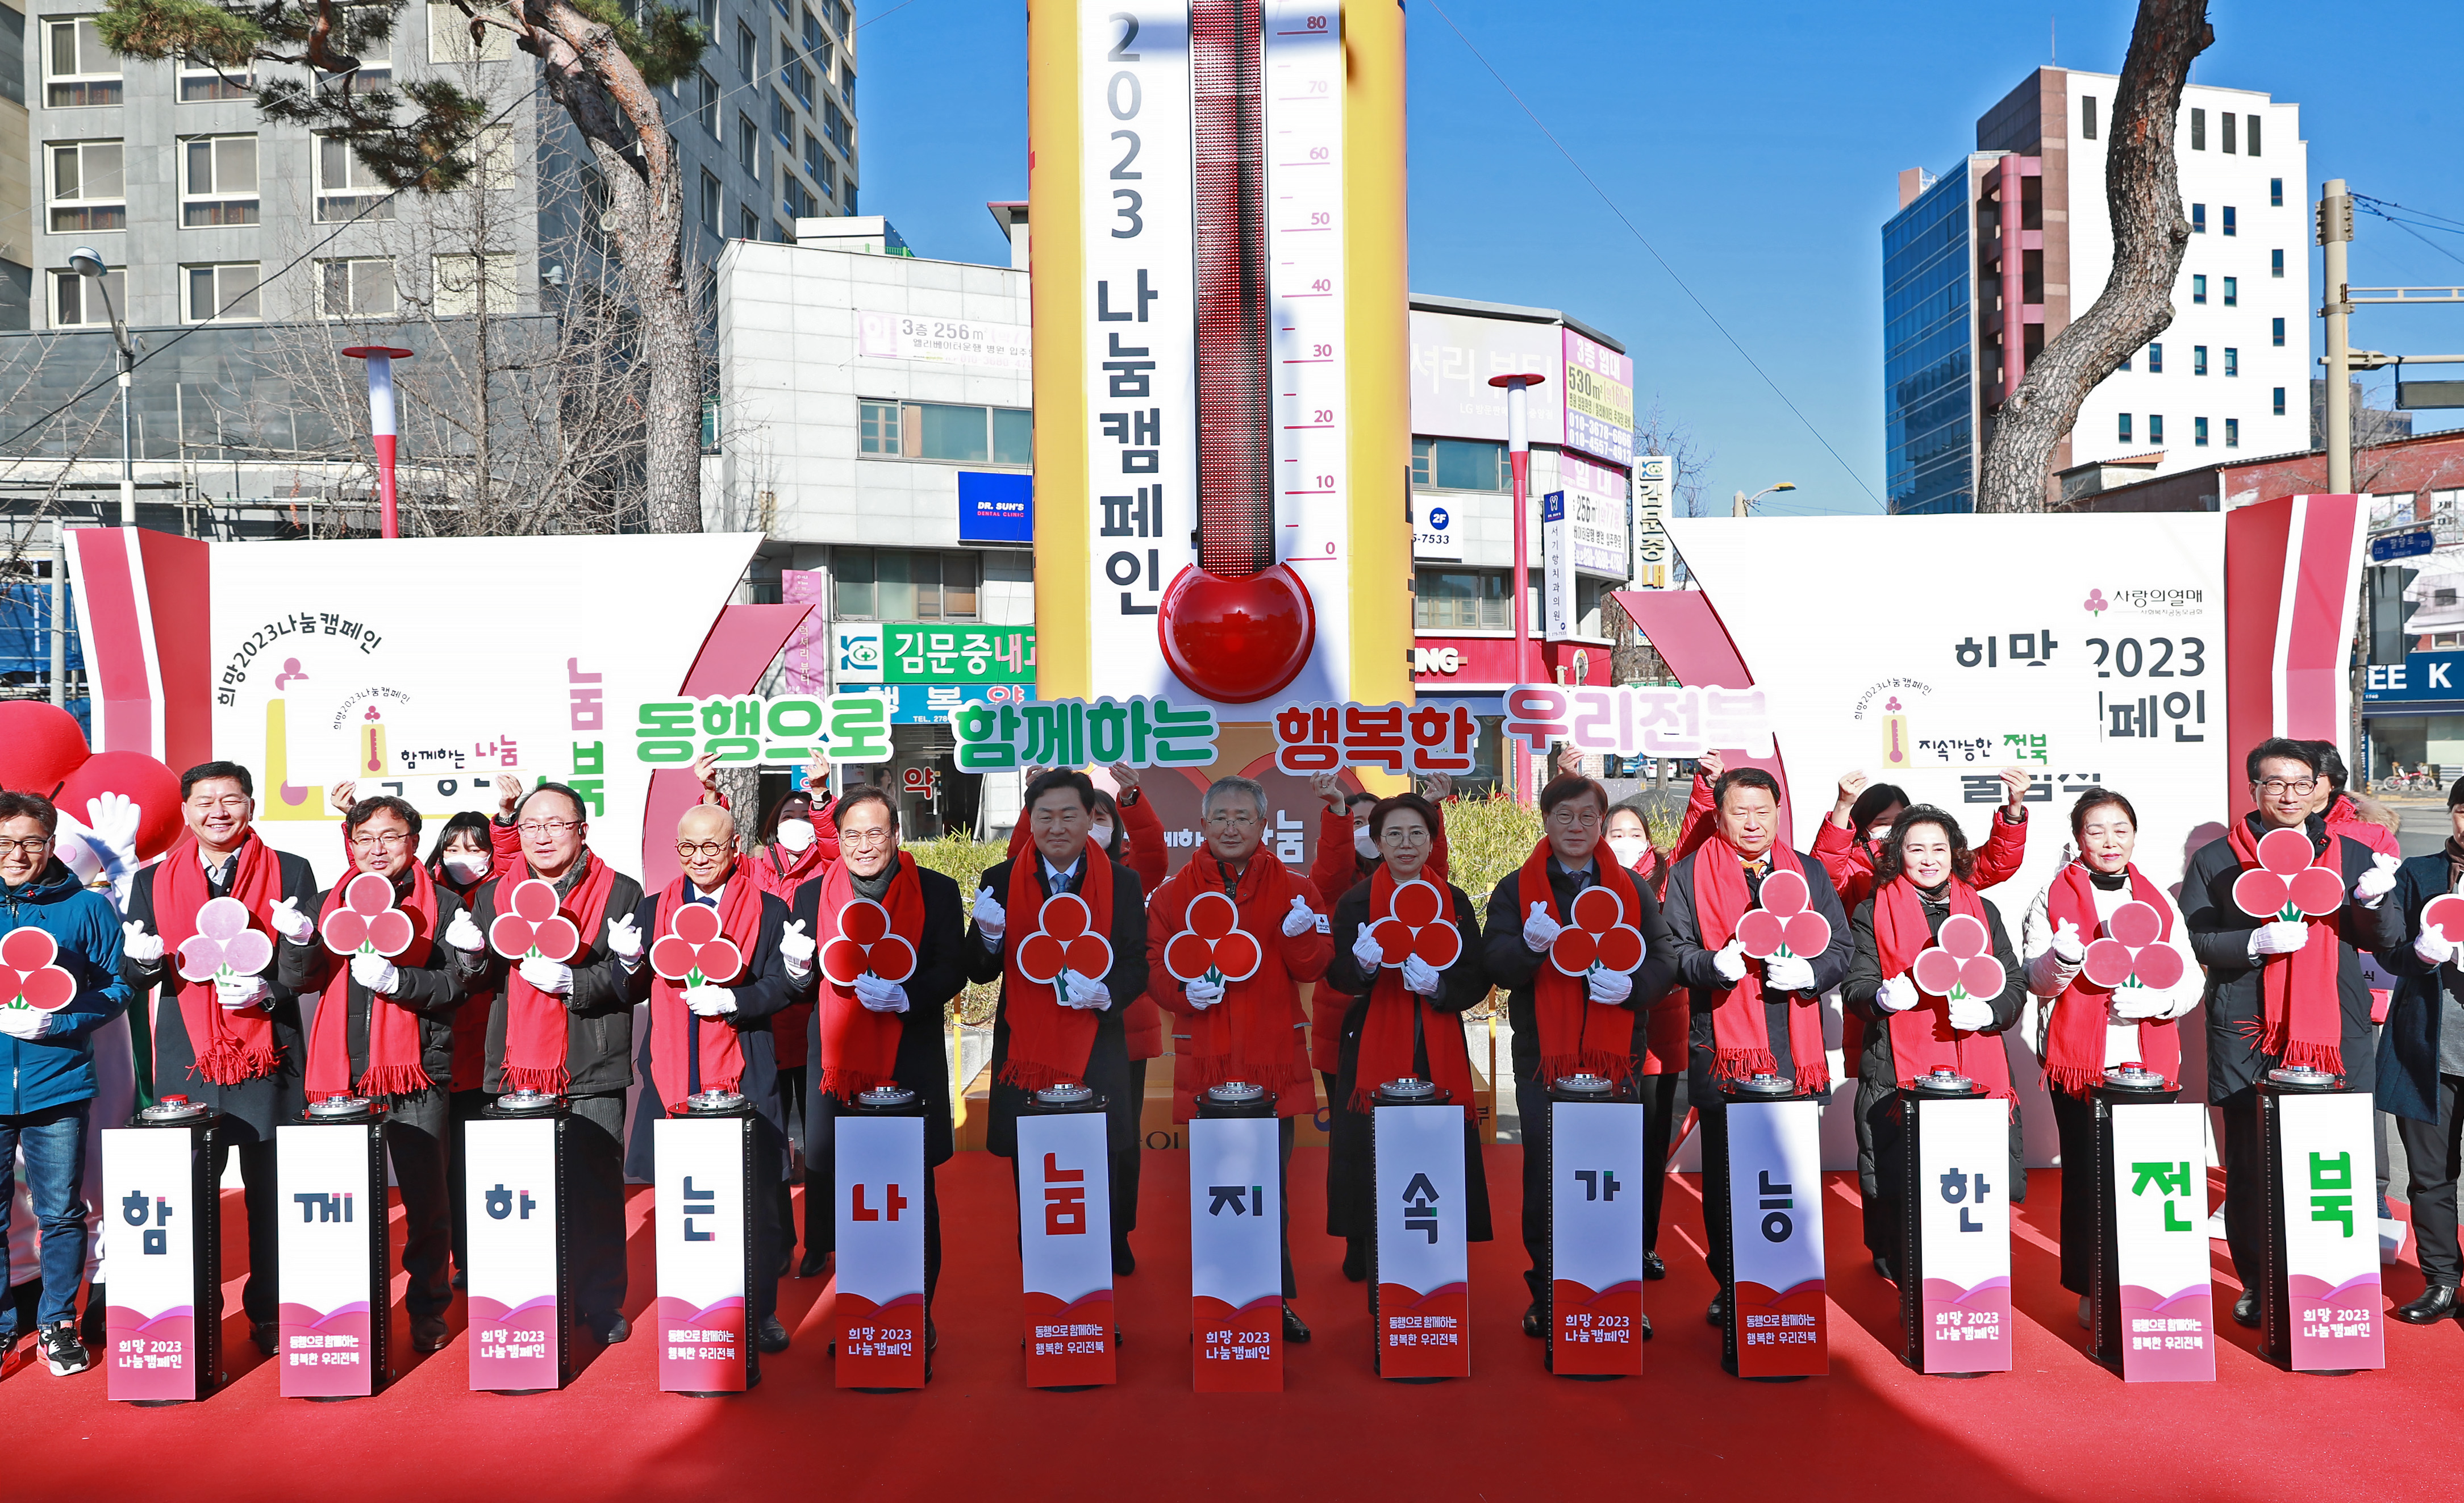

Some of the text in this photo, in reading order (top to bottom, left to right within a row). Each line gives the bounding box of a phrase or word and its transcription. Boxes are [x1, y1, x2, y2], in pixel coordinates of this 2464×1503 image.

[1307, 16, 1327, 30] 80
[1308, 81, 1328, 94] 70
[1309, 147, 1329, 160] 60
[1311, 212, 1331, 225] 50
[1311, 279, 1331, 292] 40
[933, 322, 969, 340] 256
[986, 344, 1005, 355] 병원
[1313, 344, 1333, 357] 30
[1598, 348, 1621, 381] 임대
[1569, 365, 1591, 397] 530
[1314, 410, 1334, 423] 20
[1569, 411, 1632, 448] 010-3678-6666
[1569, 428, 1632, 464] 010-4557-4913
[1316, 476, 1335, 489] 10
[977, 501, 1025, 511] DR. SUH'S
[1577, 494, 1590, 523] 256
[1432, 513, 1446, 523] 2F
[1325, 542, 1336, 555] 0
[2113, 589, 2202, 607] 사랑의열매
[2429, 663, 2452, 688] K
[1508, 689, 1769, 751] 우리전북
[2099, 689, 2205, 743] 페인
[636, 698, 888, 763] 동행으로
[955, 700, 1214, 767] 함께하는
[1276, 706, 1475, 770] 행복한
[401, 734, 518, 769] 함께하는 나눔
[1919, 734, 2048, 765] 지속가능한 전북
[903, 767, 935, 800] 약
[1575, 1170, 1621, 1201] 가
[1044, 1152, 1087, 1236] 눔
[1208, 1185, 1263, 1217] 지
[1940, 1168, 1991, 1233] 한
[2132, 1161, 2192, 1232] 전
[2309, 1151, 2354, 1238] 북
[294, 1193, 353, 1223] 께
[485, 1184, 536, 1220] 하
[683, 1176, 715, 1242] 는
[852, 1184, 907, 1221] 나
[1402, 1173, 1440, 1244] 속
[1758, 1170, 1794, 1243] 능
[123, 1190, 173, 1255] 함
[1565, 1313, 1629, 1327] 희망 2023
[1746, 1314, 1816, 1327] 동행으로 함께하는
[1936, 1311, 1999, 1325] 희망 2023
[2304, 1308, 2370, 1322] 희망 2023
[1389, 1316, 1457, 1329] 동행으로 함께하는
[2132, 1318, 2202, 1332] 동행으로 함께하는
[481, 1329, 545, 1343] 희망 2023
[668, 1330, 734, 1342] 동행으로 함께하는
[849, 1327, 912, 1340] 희망 2023
[1035, 1324, 1103, 1338] 동행으로 함께하는
[1206, 1330, 1270, 1344] 희망 2023
[1565, 1329, 1629, 1343] 나눔캠페인
[1936, 1326, 1999, 1340] 나눔캠페인
[2304, 1323, 2370, 1338] 나눔캠페인
[290, 1335, 359, 1348] 동행으로 함께하는
[1389, 1333, 1458, 1346] 행복한 우리전북
[1746, 1331, 1816, 1345] 행복한 우리전북
[2132, 1336, 2203, 1350] 행복한 우리전북
[119, 1339, 182, 1353] 희망 2023
[481, 1344, 545, 1358] 나눔캠페인
[849, 1342, 912, 1356] 나눔캠페인
[1035, 1341, 1104, 1355] 행복한 우리전북
[1206, 1346, 1270, 1360] 나눔캠페인
[290, 1352, 360, 1365] 행복한 우리전북
[668, 1347, 735, 1360] 행복한 우리전북
[119, 1354, 182, 1369] 나눔캠페인
